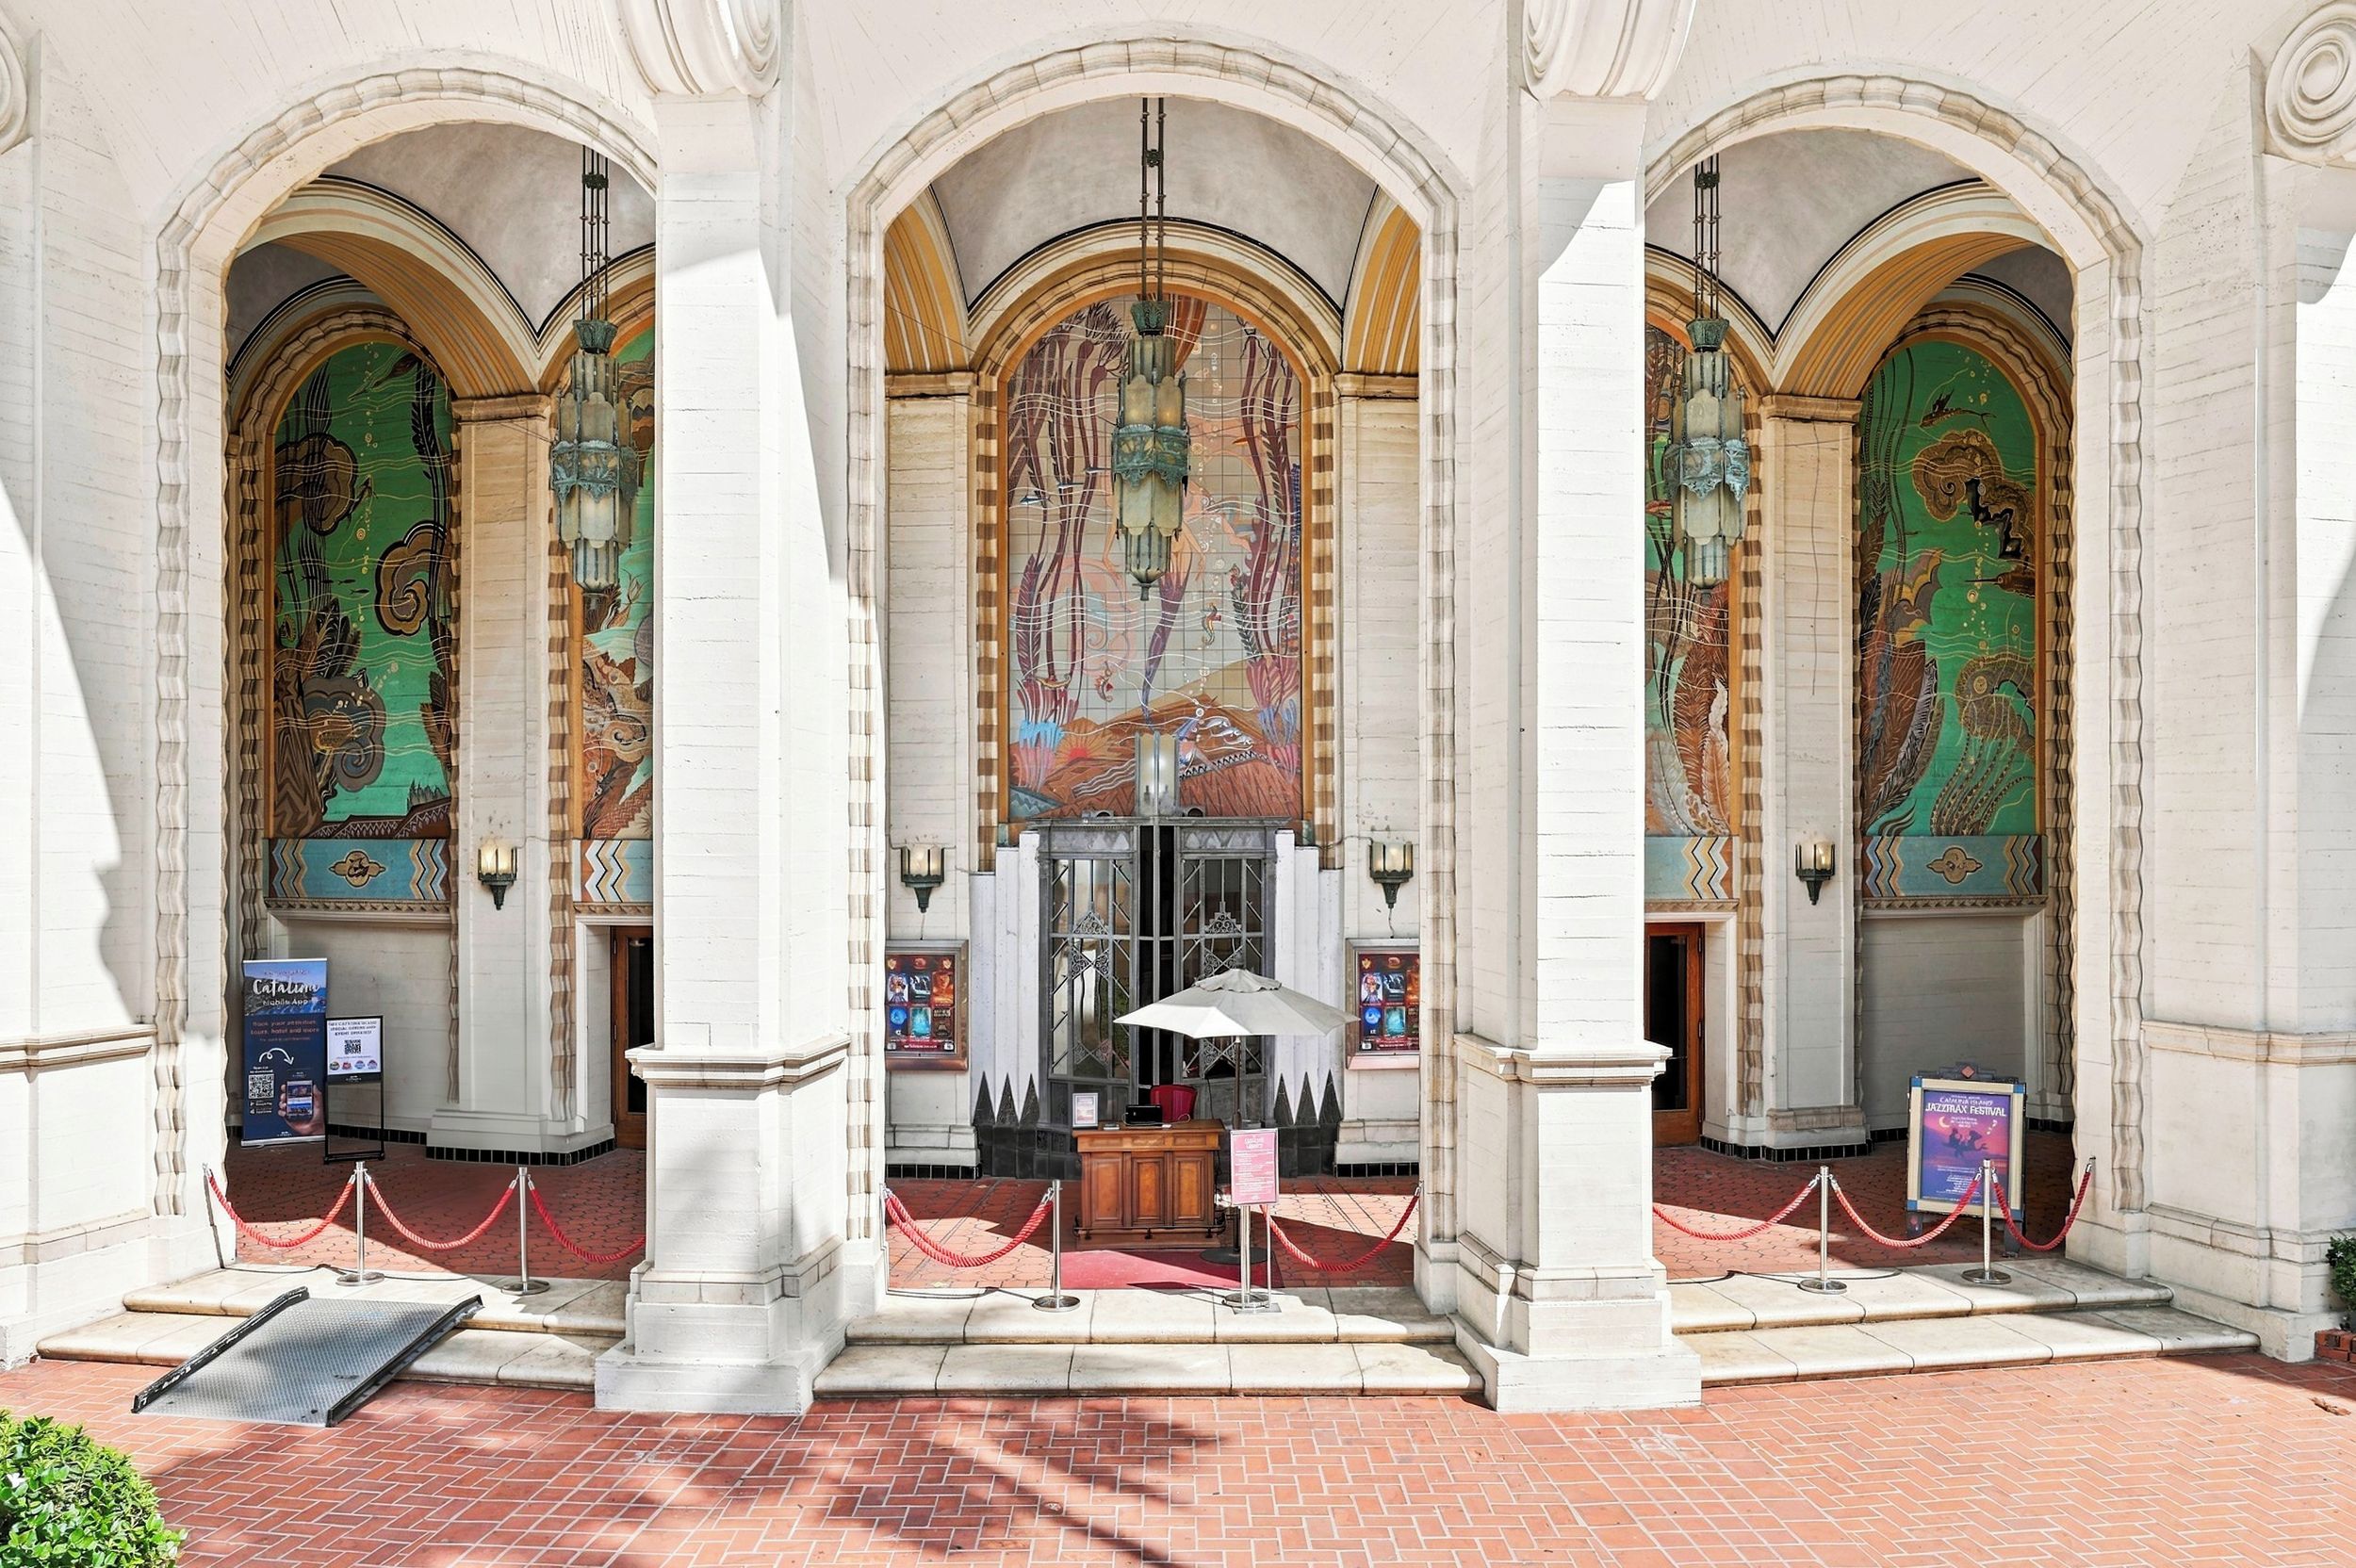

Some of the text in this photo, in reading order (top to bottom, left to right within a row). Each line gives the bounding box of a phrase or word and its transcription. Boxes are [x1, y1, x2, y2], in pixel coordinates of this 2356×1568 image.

[253, 976, 319, 997] Catalina
[1925, 1102, 2006, 1117] JAZZTRAX FESTIVAL
[1939, 1097, 1969, 1105] CATALINA
[1970, 1099, 1994, 1107] ISLAND
